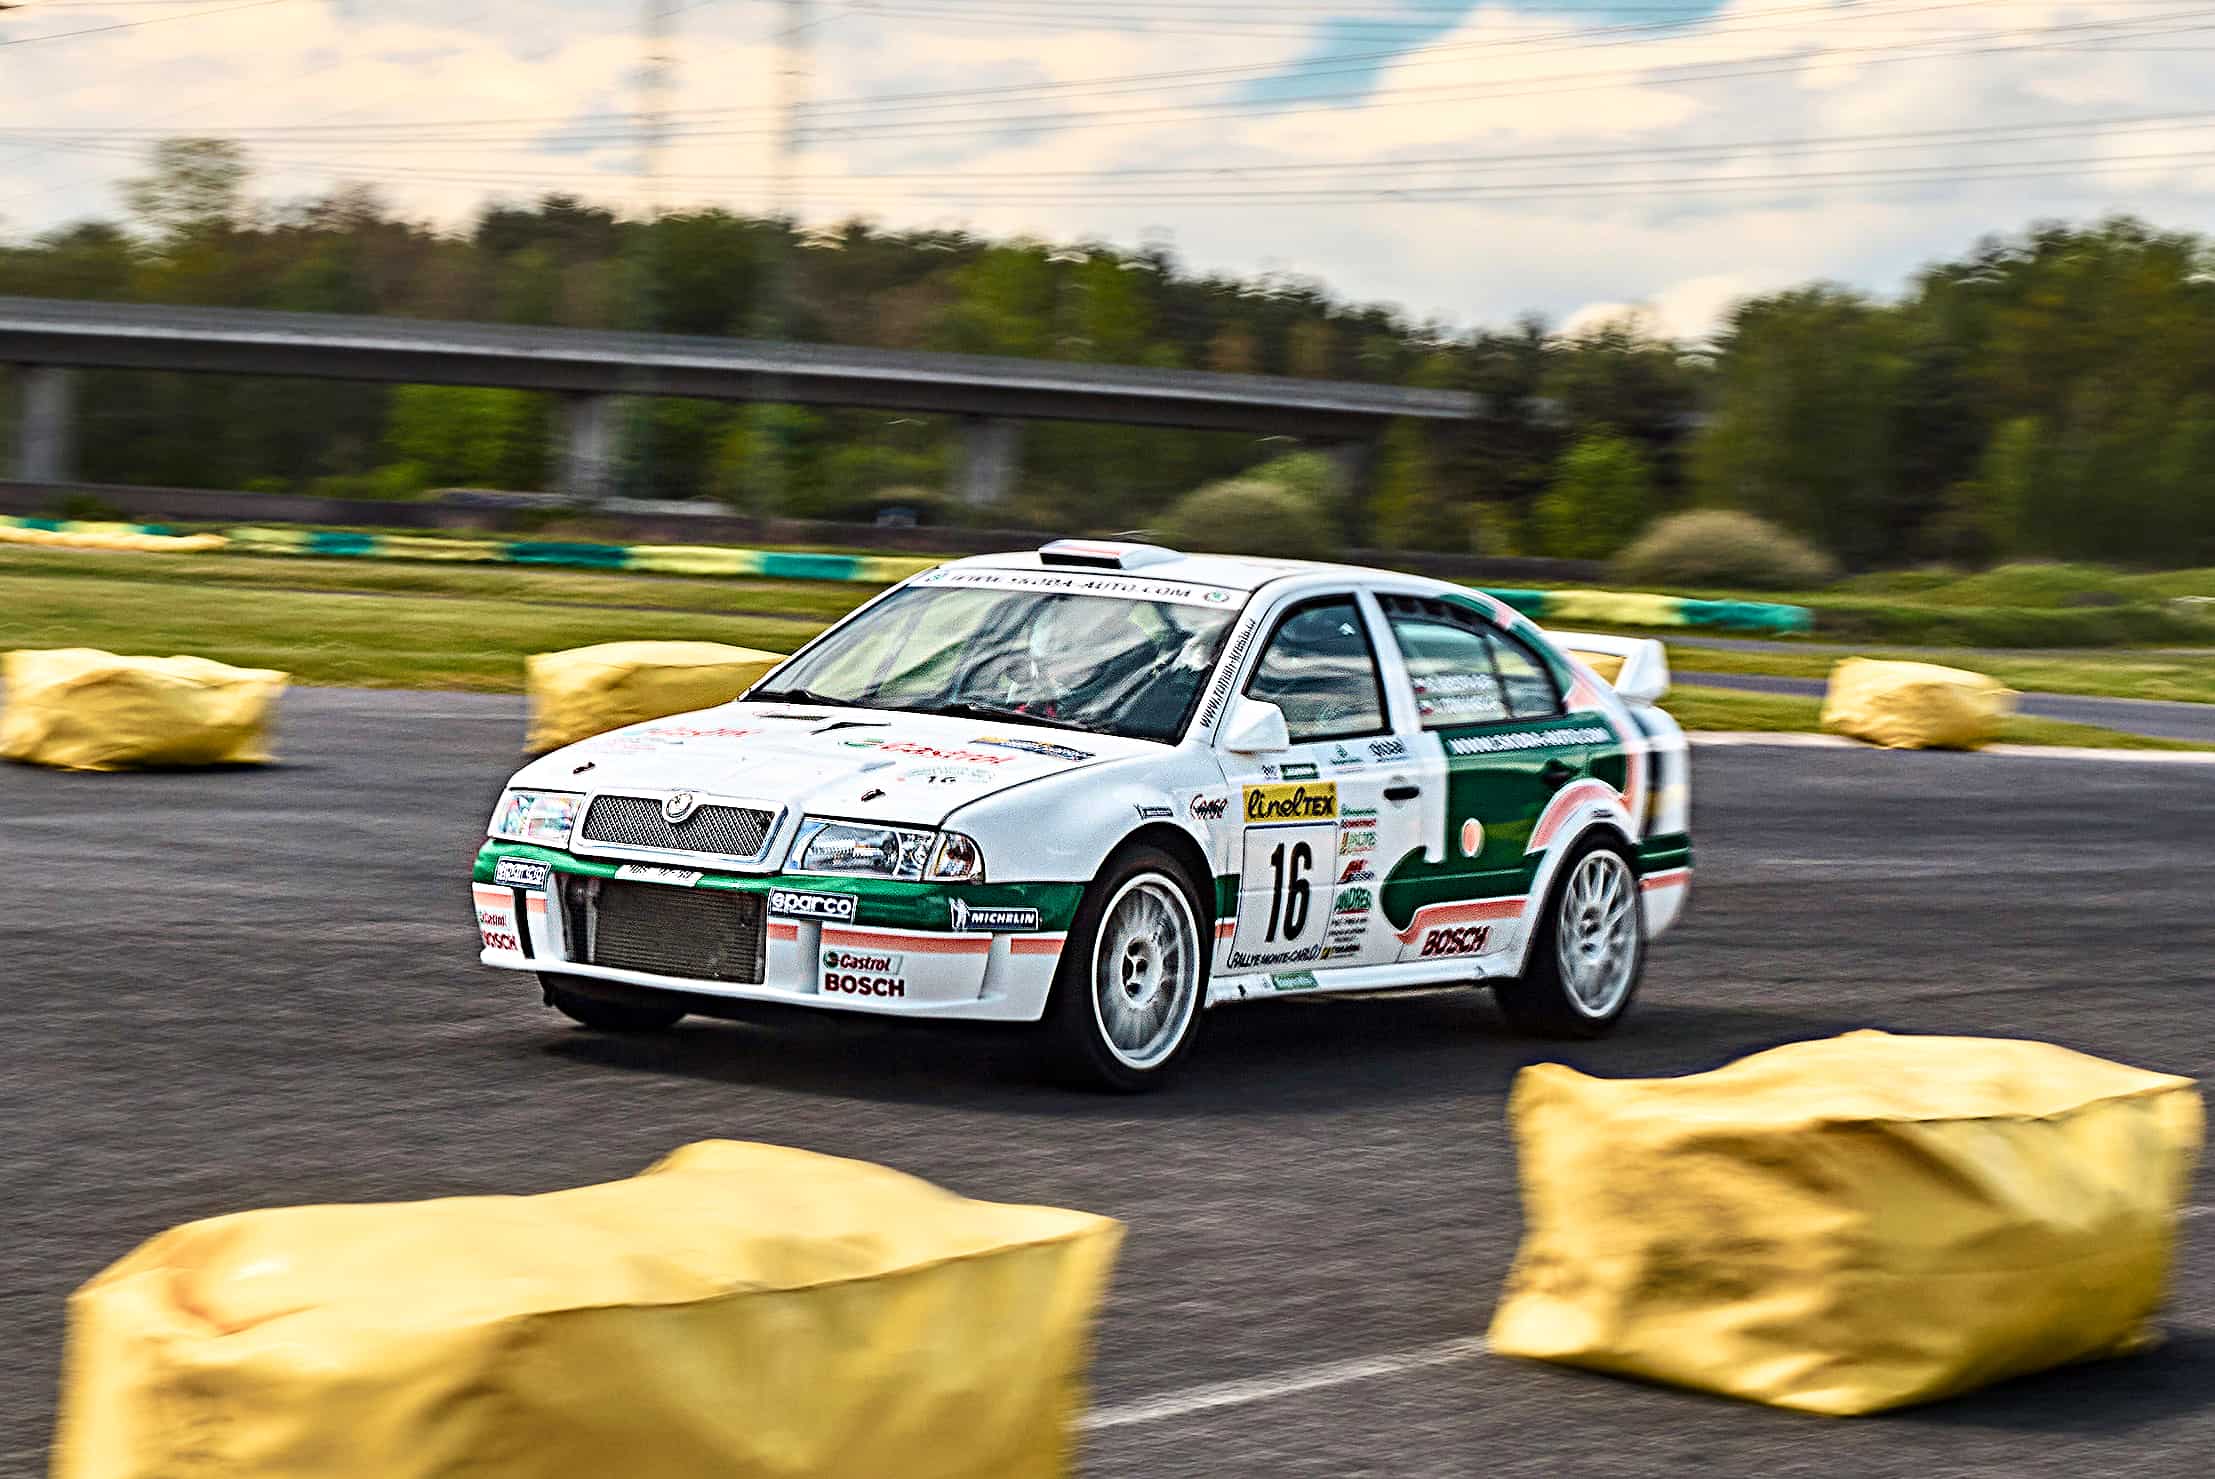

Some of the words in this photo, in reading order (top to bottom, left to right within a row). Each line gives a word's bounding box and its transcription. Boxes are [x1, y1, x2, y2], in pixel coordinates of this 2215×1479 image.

[771, 891, 852, 916] sparco
[1265, 841, 1312, 943] 16
[971, 911, 1036, 925] MICHELIN
[1421, 926, 1491, 956] BOSCH
[839, 953, 891, 973] Castrol
[1232, 950, 1260, 968] RALLYE
[1260, 943, 1320, 965] MONTE-CARLO
[824, 973, 905, 997] BOSCH
